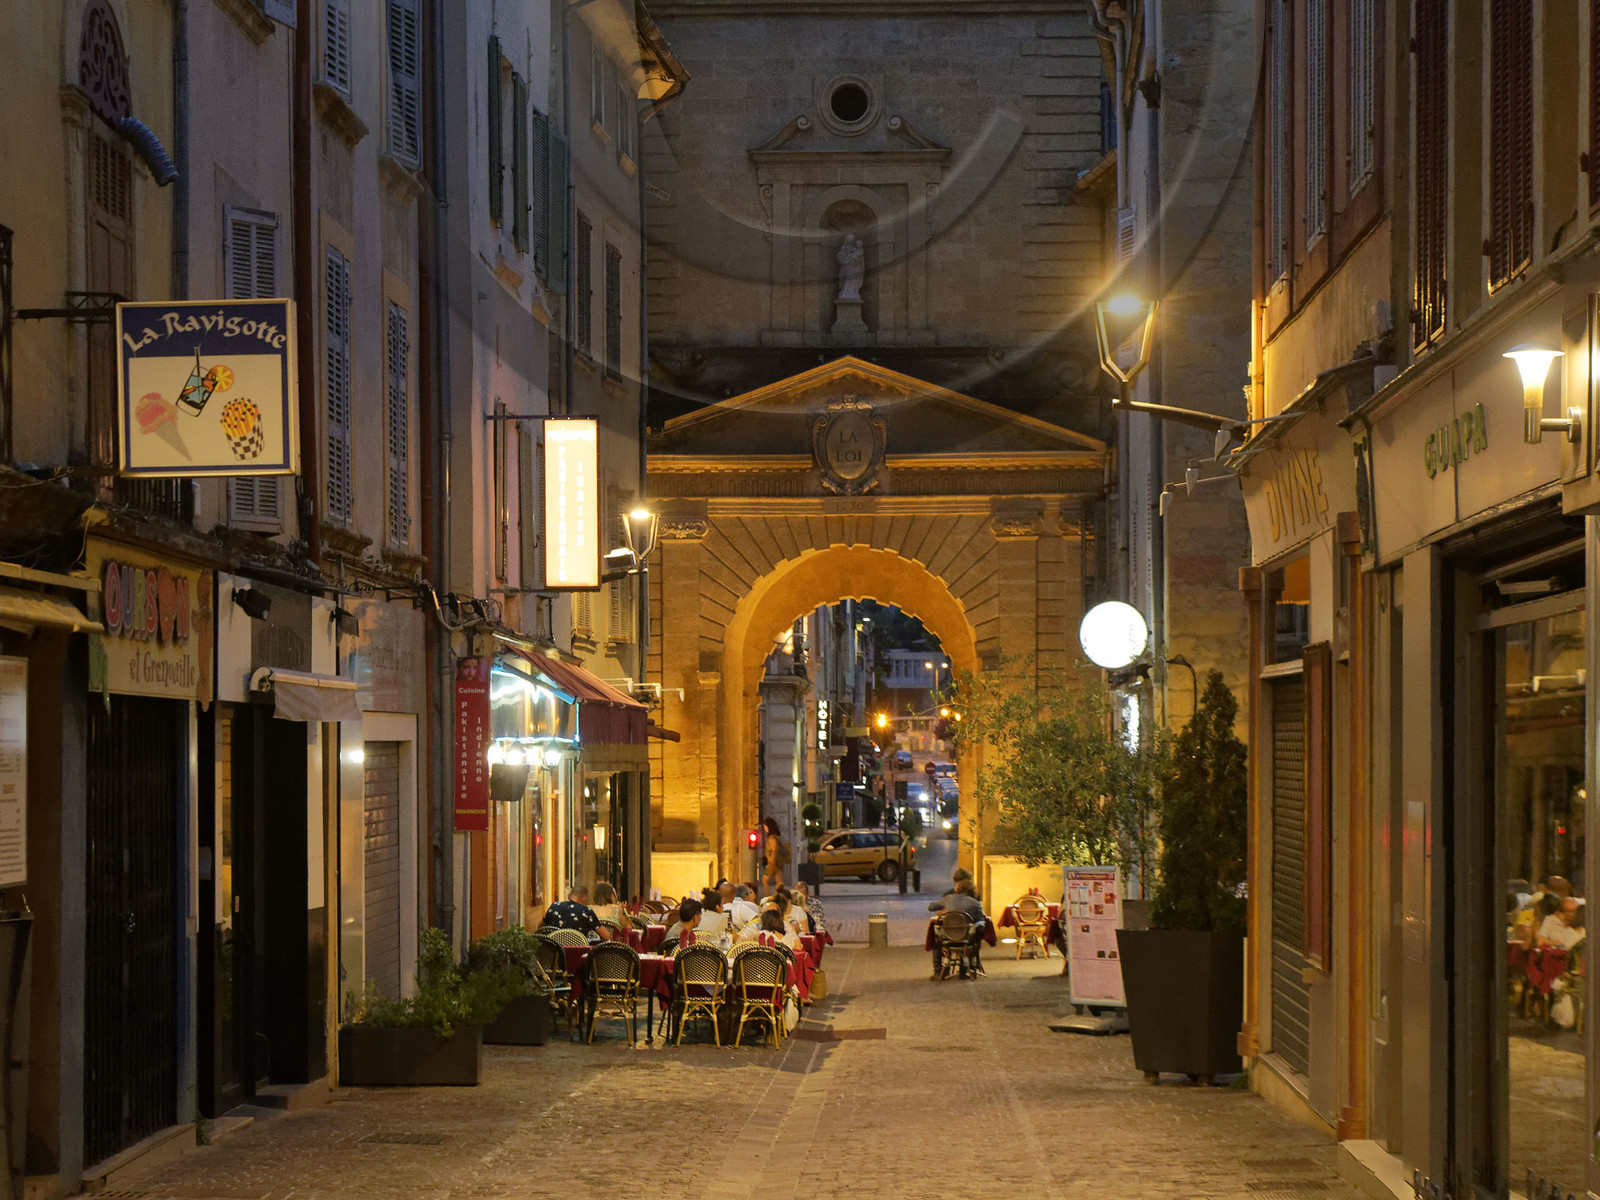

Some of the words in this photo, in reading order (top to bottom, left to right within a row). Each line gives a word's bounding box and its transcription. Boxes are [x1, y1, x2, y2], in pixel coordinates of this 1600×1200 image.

[123, 327, 166, 353] La
[156, 309, 287, 349] Ravigotte
[836, 450, 863, 463] LOI
[840, 431, 858, 444] LA
[1424, 401, 1488, 480] GUAPA
[1262, 438, 1329, 543] DIVINE
[129, 647, 141, 683] et
[143, 650, 196, 688] Grenouille
[818, 700, 828, 750] HOTEL
